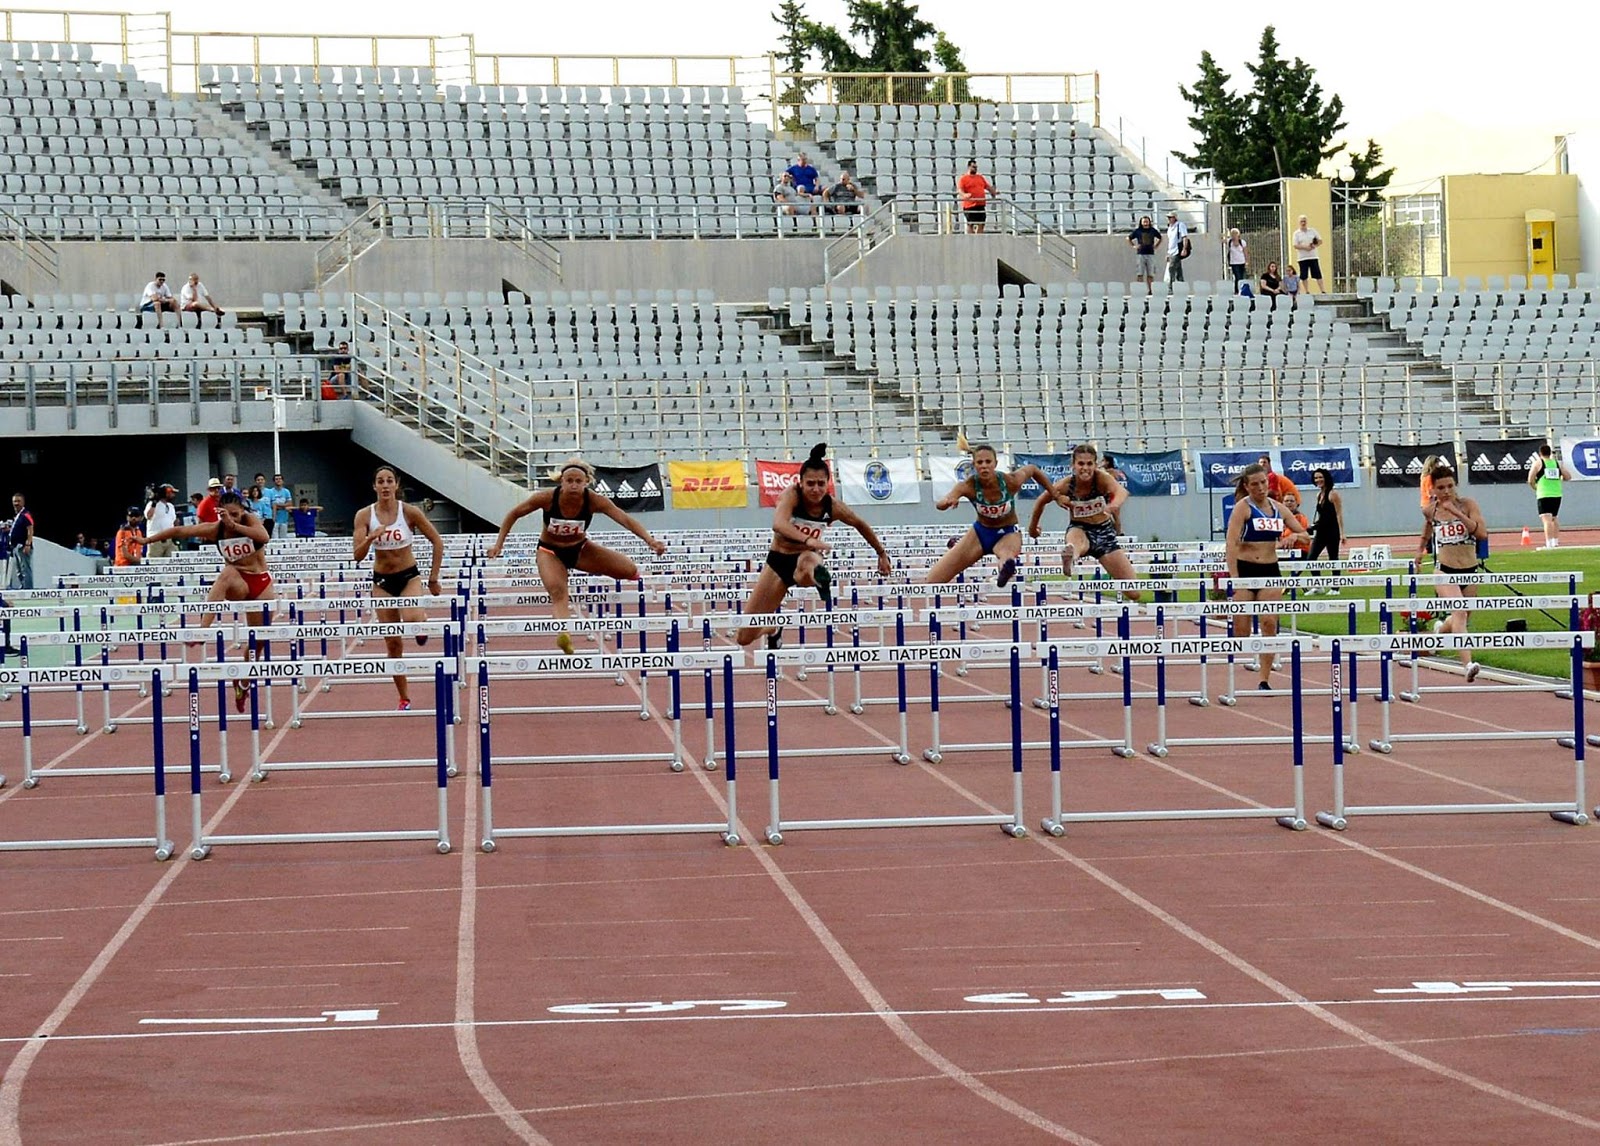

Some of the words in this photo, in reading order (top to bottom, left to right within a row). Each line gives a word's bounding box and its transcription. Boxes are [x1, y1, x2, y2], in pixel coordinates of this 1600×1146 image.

[1308, 461, 1345, 471] AEGEAN
[682, 477, 735, 492] DHL
[980, 504, 1006, 515] 397
[553, 524, 580, 535] 131
[1258, 519, 1280, 529] 331
[1440, 524, 1464, 537] 189
[224, 543, 250, 557] 160
[1265, 579, 1300, 588] ΔΗΜΟΣ
[1307, 578, 1354, 586] ΠΑΤΡΕΩΝ
[1449, 575, 1485, 584] ΔΗΜΟΣ
[1490, 574, 1537, 582] ΠΑΤΡΕΩΝ
[891, 586, 926, 594] ΔΗΜΟΣ
[932, 585, 980, 593] ΠΑΤΡΕΩΝ
[371, 599, 418, 607] ΠΑΤΡΕΩΝ
[569, 594, 606, 602] ΑΤΡΕΩΝ
[1426, 600, 1469, 609] ΔΗΜΟΣ
[1476, 598, 1533, 608] ΠΑΤΡΕΩΝ
[0, 609, 41, 617] ΑΤΡΕΩΝ
[140, 605, 176, 614] ΔΗΜΟΣ
[182, 604, 231, 612] ΠΑΤΡΕΩΝ
[1203, 604, 1246, 613] ΔΗΜΟΣ
[1253, 602, 1310, 612] ΠΑΤΡΕΩΝ
[750, 616, 793, 625] ΔΗΜΟΣ
[800, 613, 857, 624] ΠΑΤΡΕΩΝ
[976, 609, 1019, 619] ΔΗΜΟΣ
[1026, 608, 1083, 617] ΠΑΤΡΕΩΝ
[296, 627, 340, 636] ΔΗΜΟΣ
[347, 626, 404, 635] ΠΑΤΡΕΩΝ
[524, 622, 567, 632] ΔΗΜΟΣ
[574, 620, 632, 630] ΠΑΤΡΕΩΝ
[68, 633, 112, 643] ΔΗΜΟΣ
[119, 631, 177, 641] ΠΑΤΡΕΩΝ
[1390, 637, 1444, 648] ΔΗΜΟΣ
[1453, 635, 1525, 647] ΠΑΤΡΕΩΝ
[1108, 642, 1162, 655] ΔΗΜΟΣ
[1172, 640, 1243, 652] ΠΑΤΡΕΩΝ
[825, 650, 880, 663] ΔΗΜΟΣ
[890, 647, 961, 660] ΠΑΤΡΕΩΝ
[537, 658, 592, 670] ΔΗΜΟΣ
[602, 655, 674, 668] ΠΑΤΡΕΩΝ
[249, 664, 304, 677] ΔΗΜΟΣ
[313, 662, 386, 674] ΠΑΤΡΕΩΝ
[29, 670, 102, 682] ΠΑΤΡΕΩΝ
